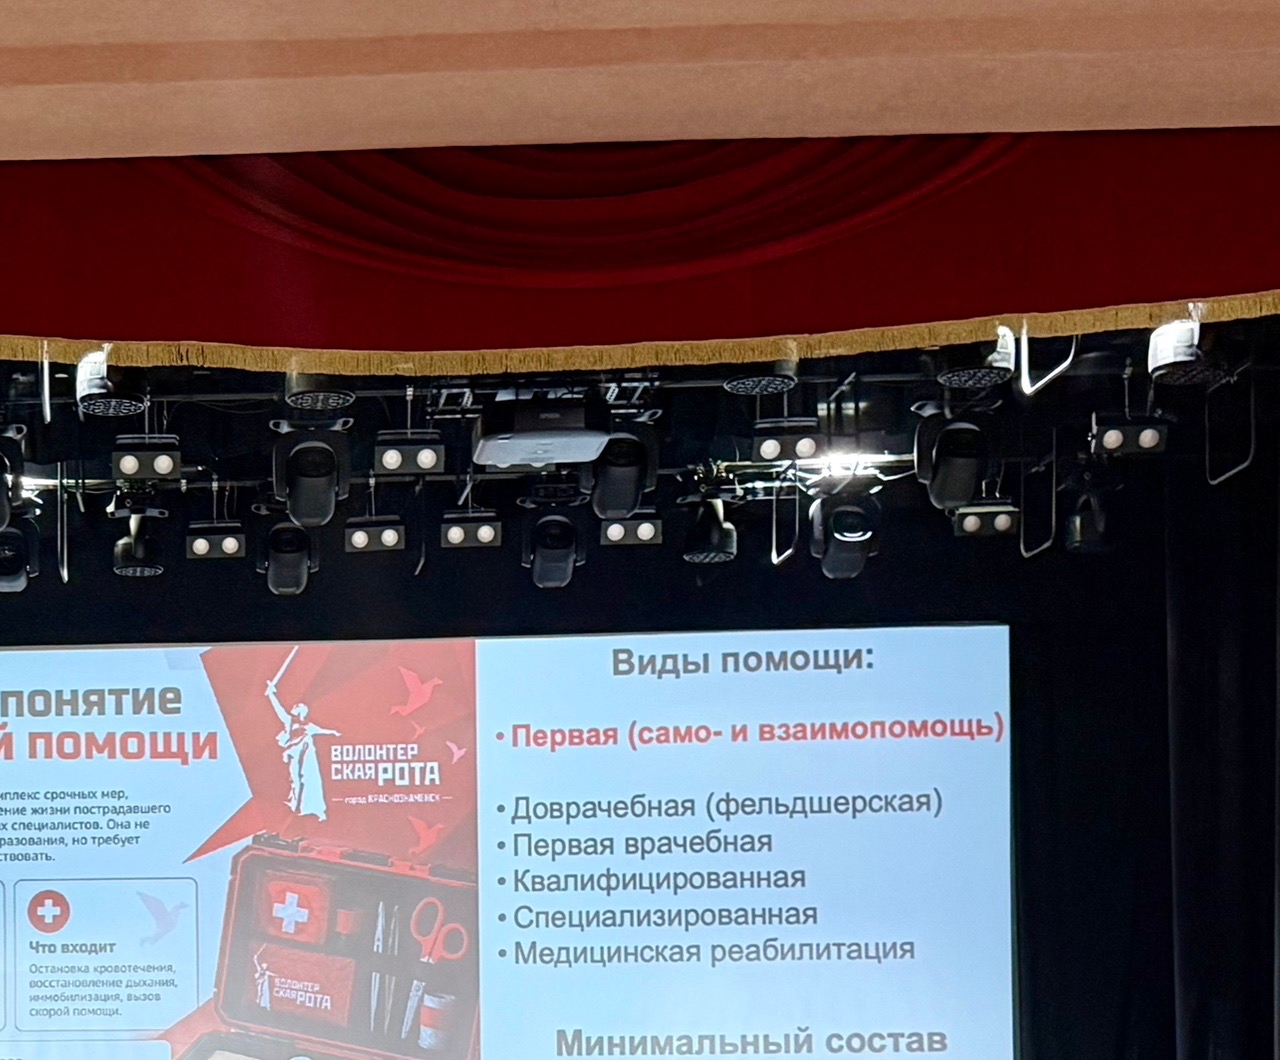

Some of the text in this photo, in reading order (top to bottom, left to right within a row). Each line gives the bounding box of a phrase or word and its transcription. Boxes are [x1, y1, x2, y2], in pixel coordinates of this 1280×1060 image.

[613, 648, 873, 679] Виды помощи:
[0, 687, 181, 717] понятие
[512, 711, 1003, 752] Первая (само- и взаимопомощь)
[28, 731, 217, 765] помощи
[331, 744, 418, 761] ВОЛОНТЕР
[331, 762, 440, 786] СКАЯ РОТА
[44, 790, 97, 803] срочных
[101, 789, 128, 802] мер,
[511, 788, 942, 825] Доврачебная (фельдшерская)
[31, 805, 70, 816] жизни
[74, 804, 171, 817] пострадавшего
[11, 820, 103, 833] специалистов.
[107, 818, 131, 830] Она
[135, 820, 149, 830] не
[72, 836, 87, 846] но
[91, 834, 140, 847] требует
[514, 829, 772, 862] Первая врачебная
[515, 868, 805, 896] Квалифицированная
[514, 905, 817, 932] Специализированная
[29, 941, 116, 955] Что входит
[515, 937, 915, 968] Медицинская реабилитация
[29, 963, 176, 976] Остановка кровотечения,
[29, 978, 178, 989] восстановление дыхания,
[127, 992, 161, 1002] вызов
[273, 987, 331, 1010] СКАЯ РОТА
[29, 1006, 122, 1019] скорой помощи.
[557, 1026, 947, 1056] Минимальный состав
